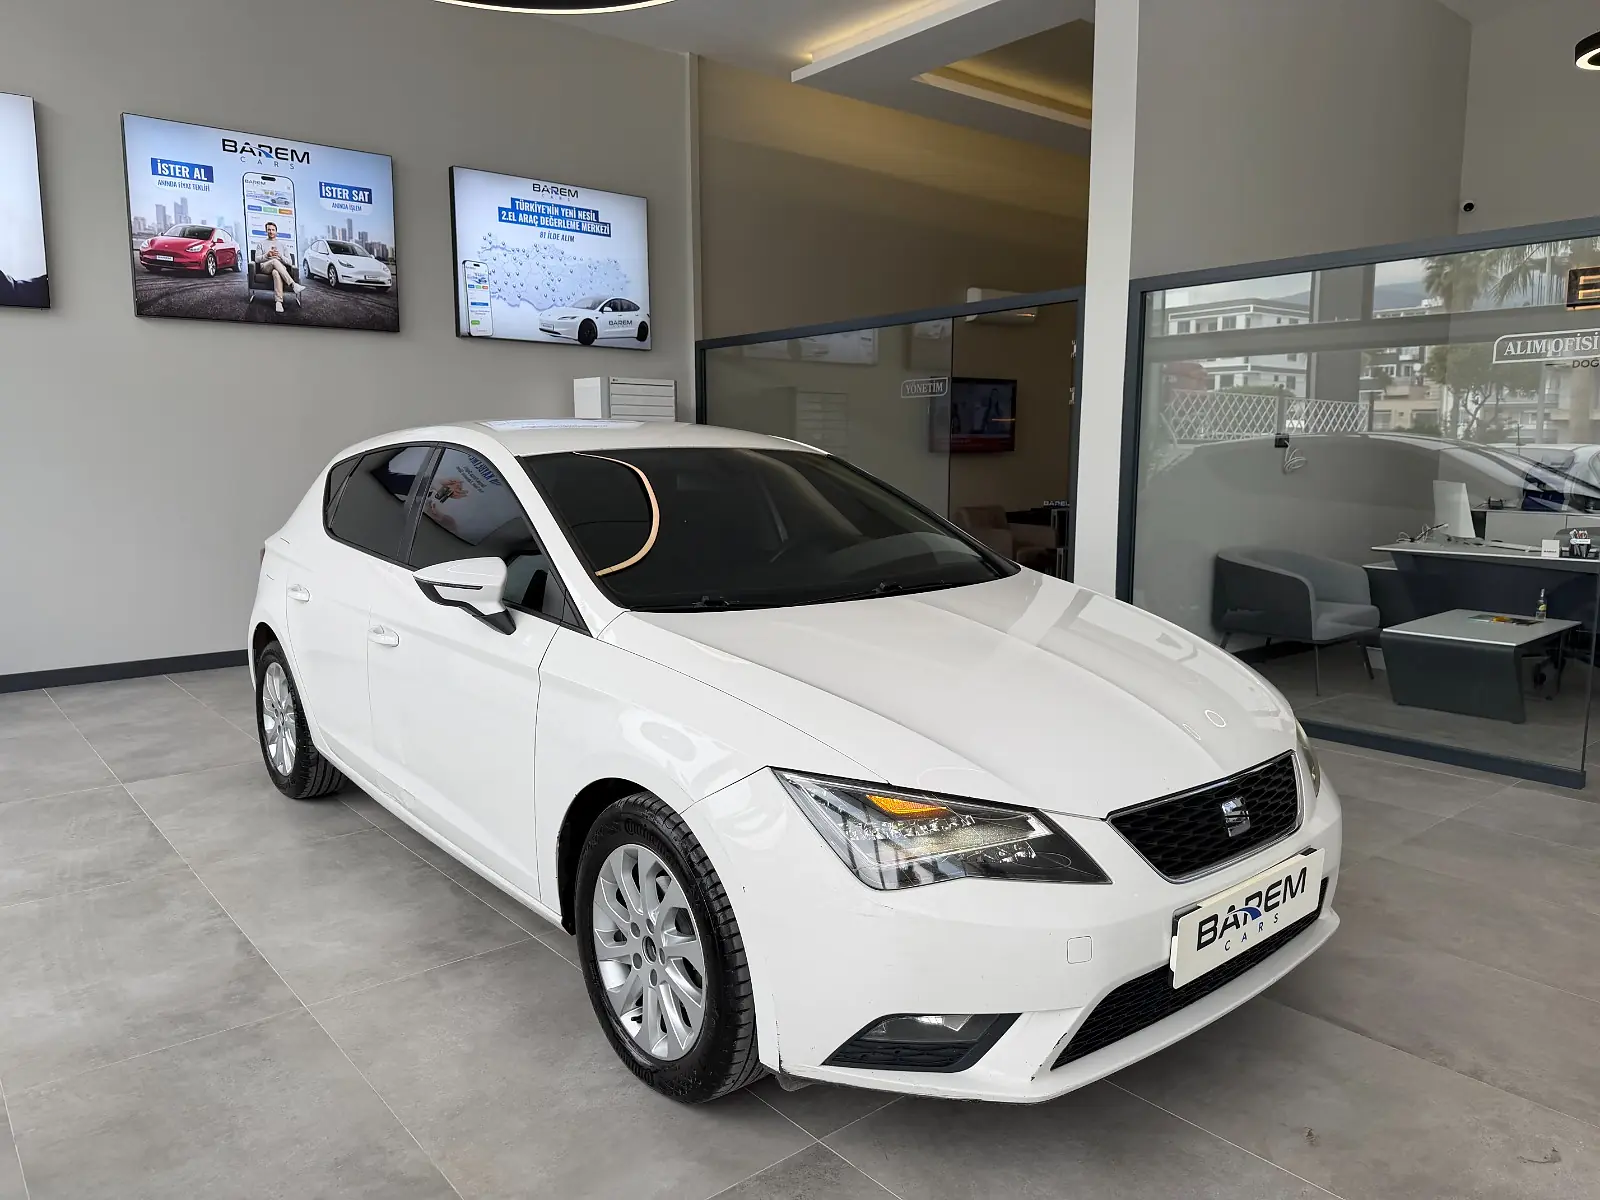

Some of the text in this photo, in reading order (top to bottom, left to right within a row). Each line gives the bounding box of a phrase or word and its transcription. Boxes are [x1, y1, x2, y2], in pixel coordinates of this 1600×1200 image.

[222, 138, 310, 164] BAREM
[157, 160, 208, 180] İSTER AL
[240, 156, 295, 170] CARS
[321, 182, 370, 203] İSTER SAT
[532, 183, 579, 199] BAREM
[515, 199, 597, 222] TÜRKİYE'NİN YENİ NESİL
[501, 211, 610, 236] 2.EL ARAÇ DEĞERLEME MERKEZİ
[1503, 332, 1600, 356] ALIM OFİSİ
[905, 380, 944, 394] YÖNETİM
[1196, 866, 1308, 952] BAREM
[1224, 912, 1280, 952] CARS
